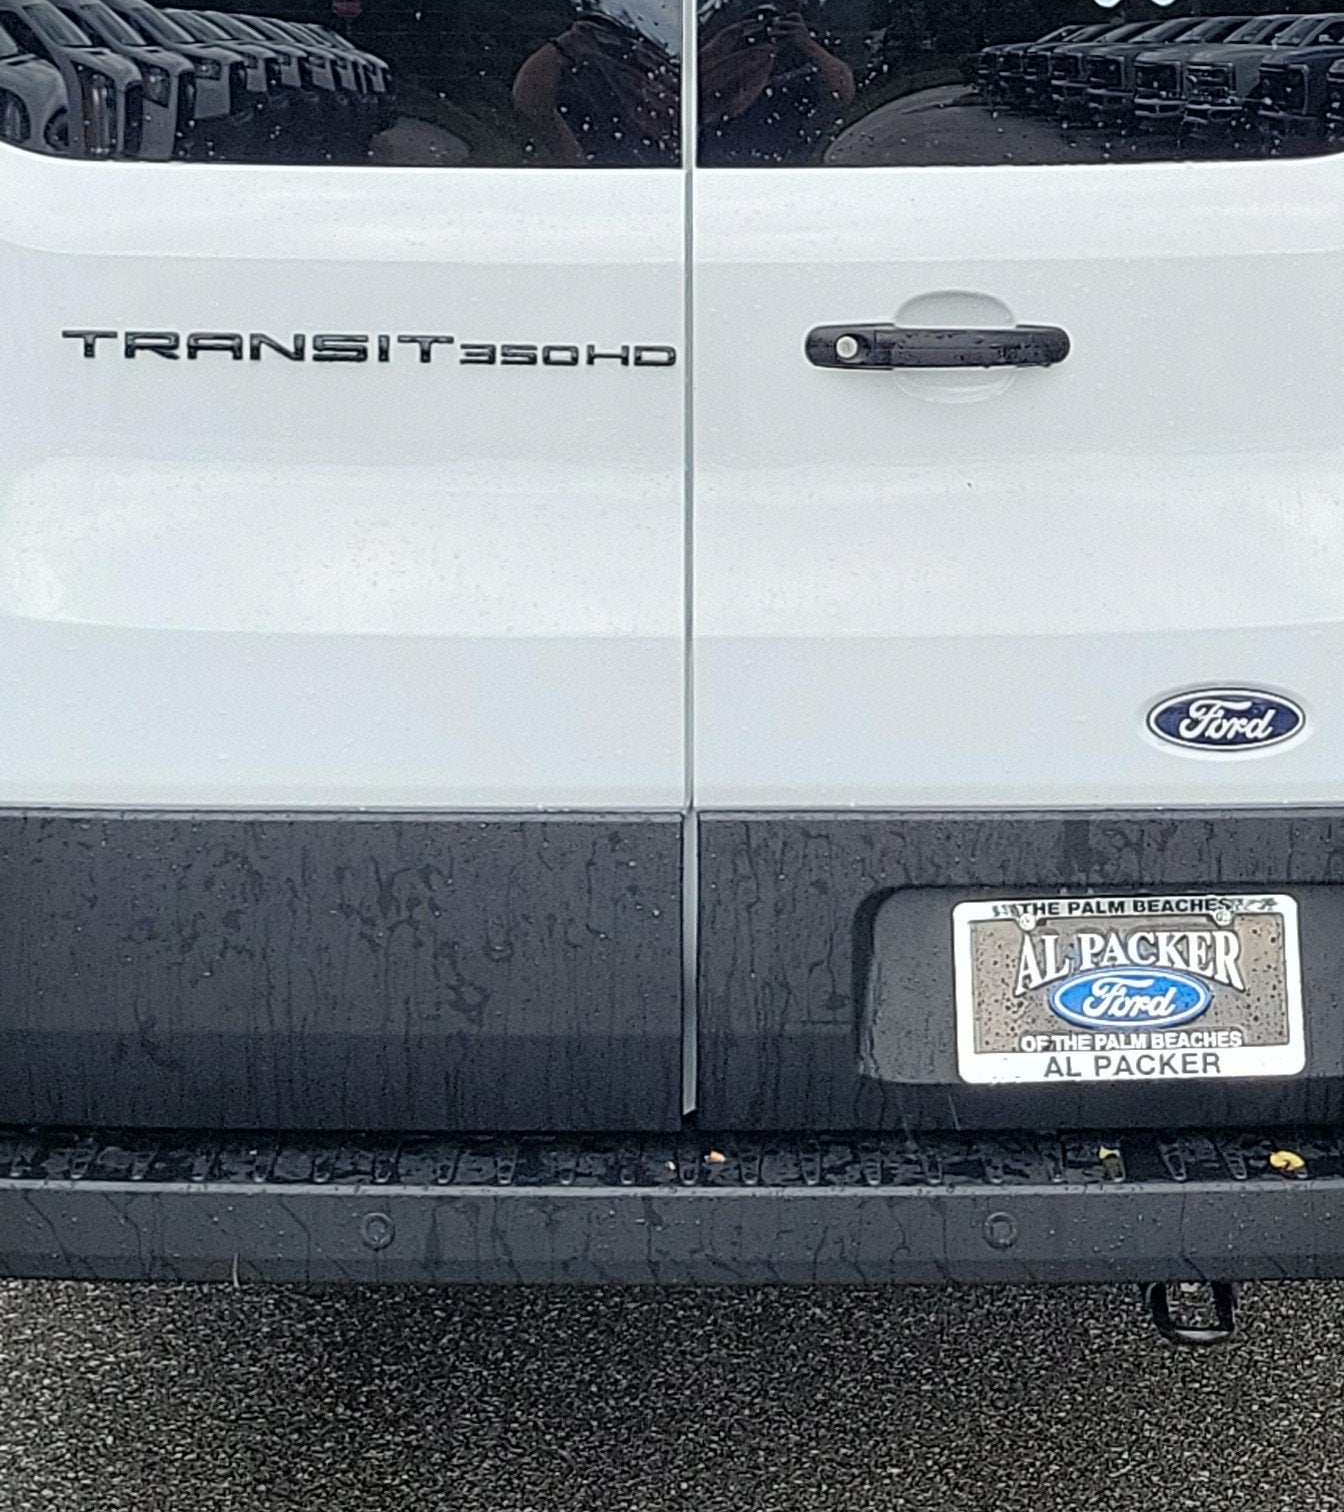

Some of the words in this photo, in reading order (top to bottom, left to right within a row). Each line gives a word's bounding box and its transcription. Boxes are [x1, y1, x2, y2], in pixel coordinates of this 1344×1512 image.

[1179, 699, 1276, 739] Ford
[1018, 902, 1059, 916] THE
[1068, 900, 1125, 915] PALM
[1133, 898, 1232, 913] BEACHES
[1015, 933, 1070, 996] AL
[1077, 930, 1246, 993] PACKER
[1083, 977, 1177, 1018] Ford
[1021, 1035, 1051, 1053] OF
[1051, 1034, 1092, 1051] THE
[1094, 1033, 1148, 1049] PALM
[1151, 1030, 1243, 1049] BEACHES
[1043, 1056, 1082, 1078] AL
[1094, 1052, 1221, 1077] PACKER
